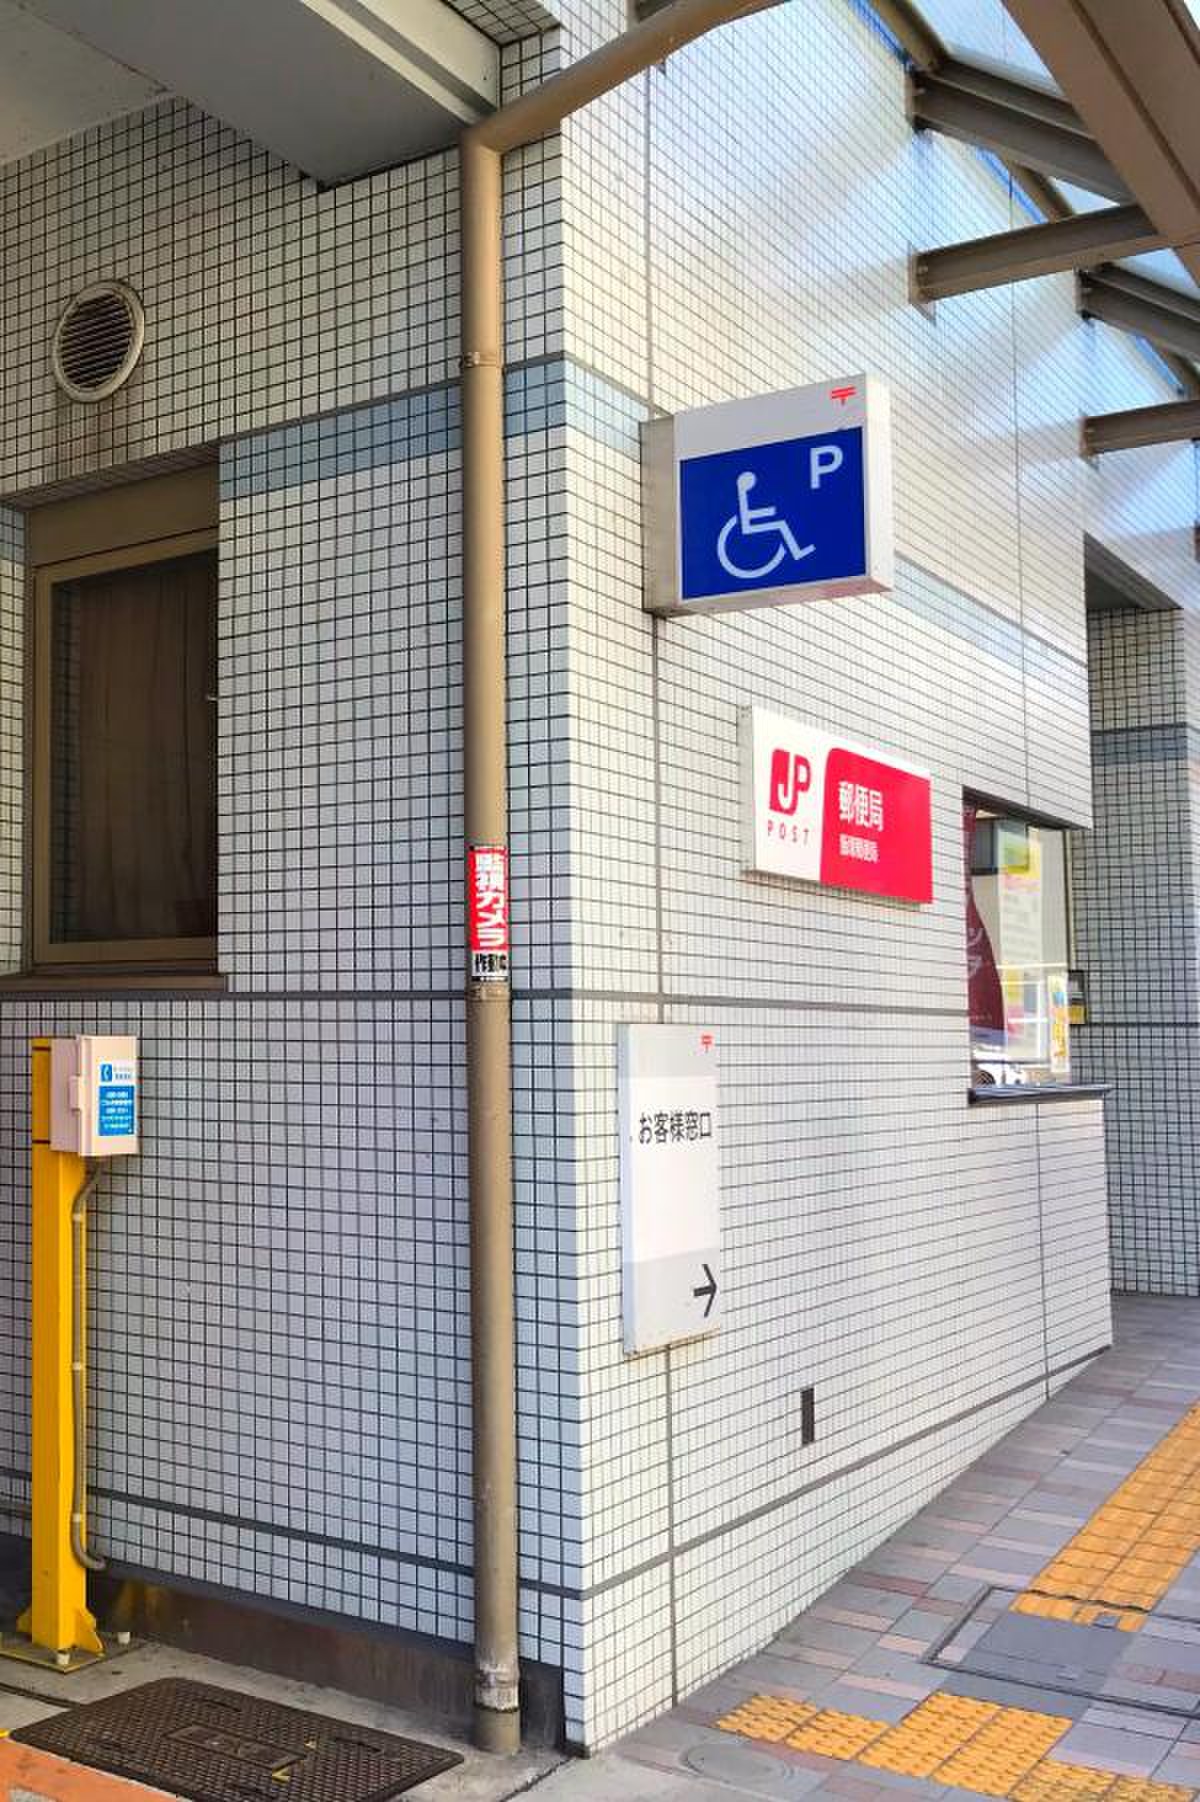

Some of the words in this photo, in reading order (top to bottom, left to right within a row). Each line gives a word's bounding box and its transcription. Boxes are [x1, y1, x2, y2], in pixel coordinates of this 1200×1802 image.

[810, 445, 843, 489] P
[769, 748, 811, 816] JP
[838, 780, 883, 832] 郵便局
[768, 820, 810, 845] POST
[639, 1111, 711, 1144] お客様窓口
